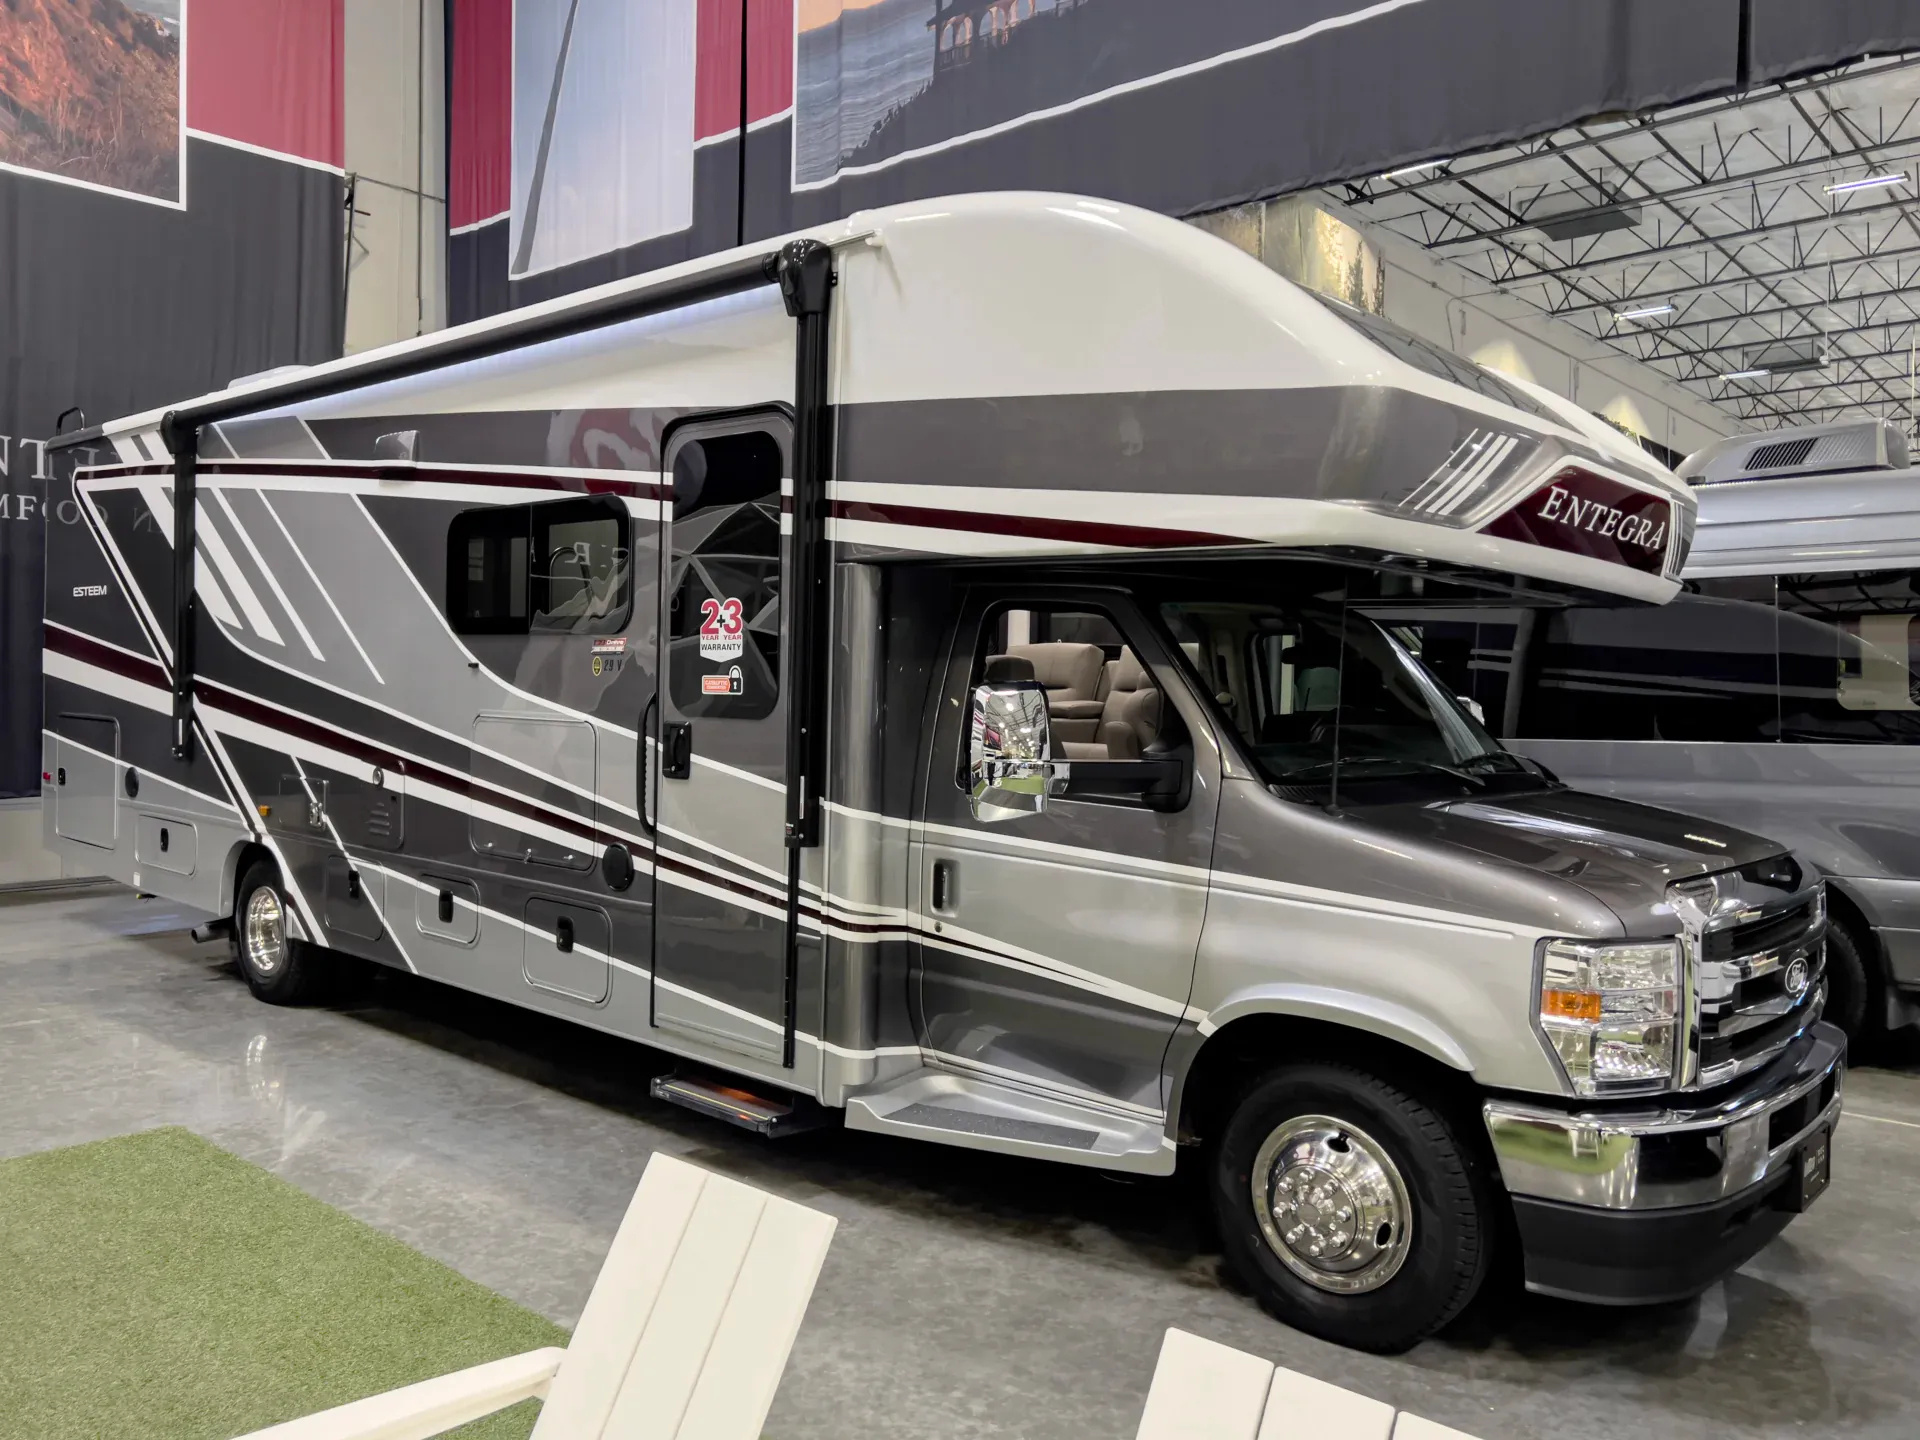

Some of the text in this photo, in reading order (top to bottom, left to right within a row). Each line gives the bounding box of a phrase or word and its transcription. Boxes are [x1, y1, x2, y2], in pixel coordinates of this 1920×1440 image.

[1537, 485, 1665, 550] ENTEGRA
[72, 585, 107, 597] ESTEEM
[701, 643, 742, 651] WARRANTY
[604, 660, 613, 671] 29
[617, 660, 622, 671] V
